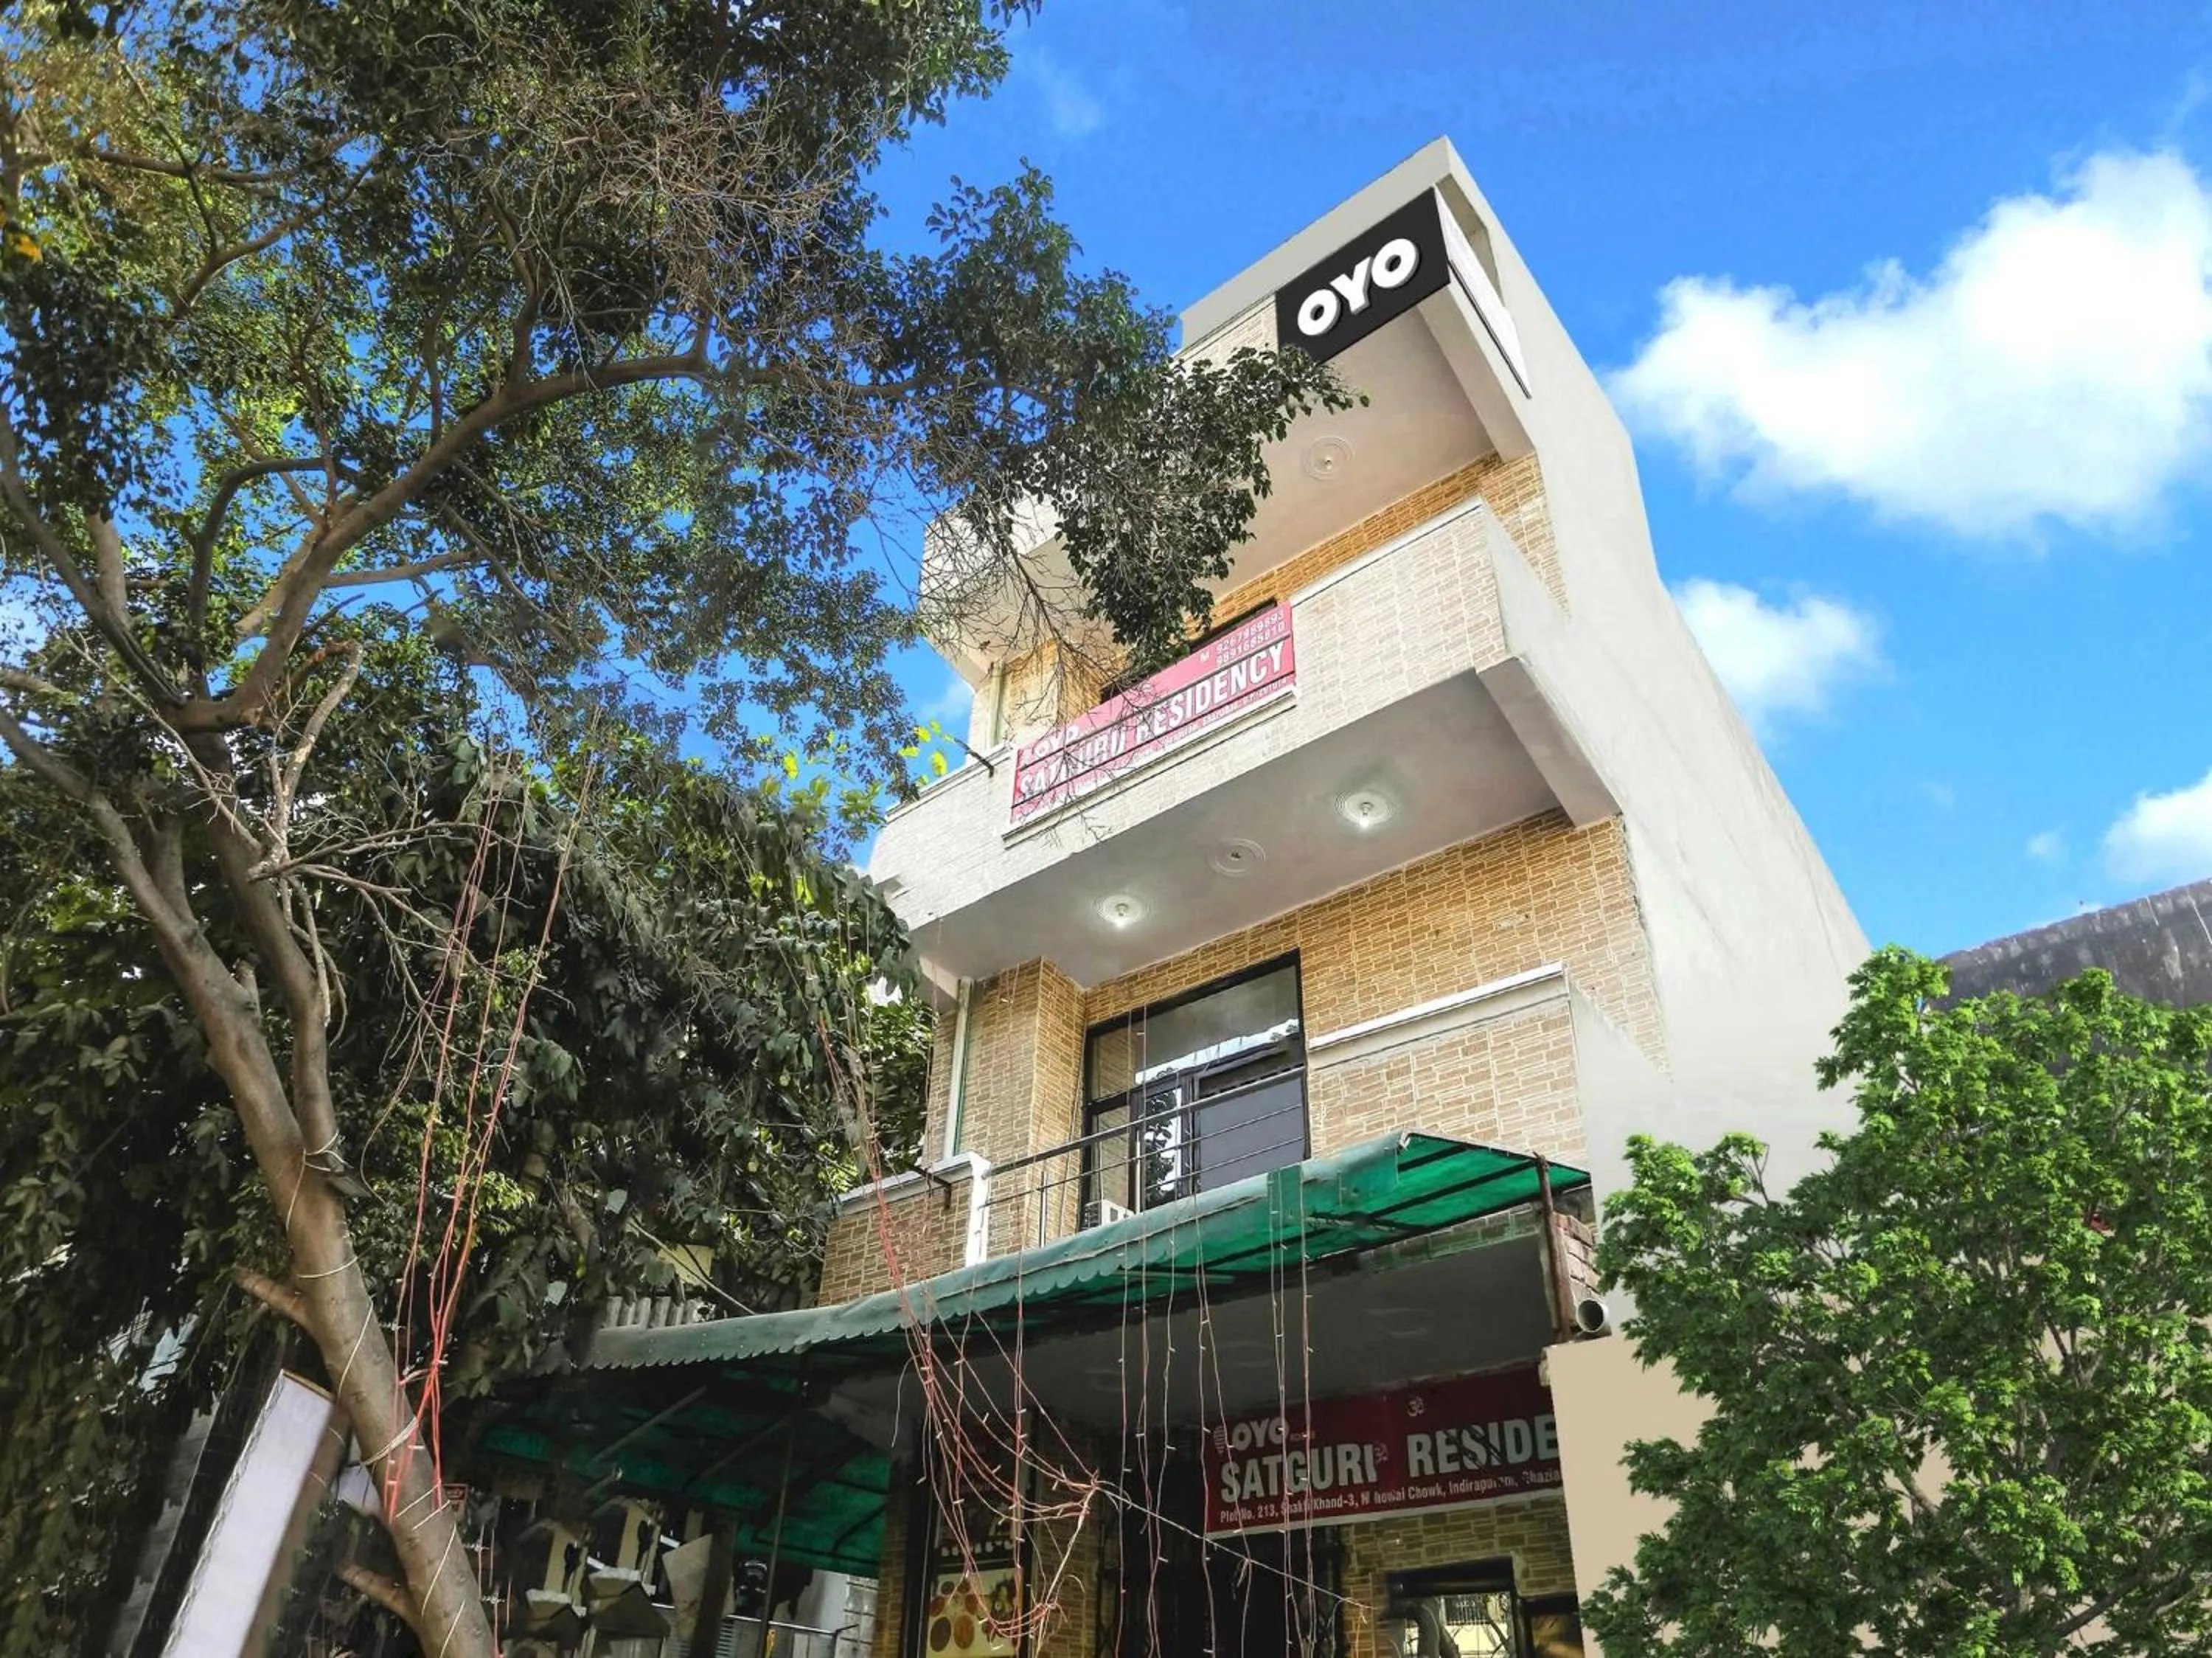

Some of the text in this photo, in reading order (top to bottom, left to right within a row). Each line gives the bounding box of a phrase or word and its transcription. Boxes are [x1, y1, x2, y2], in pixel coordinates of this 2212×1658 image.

[1297, 237, 1419, 336] OYO
[1137, 640, 1286, 745] RESIDENCY
[1231, 1416, 1290, 1451] OYO
